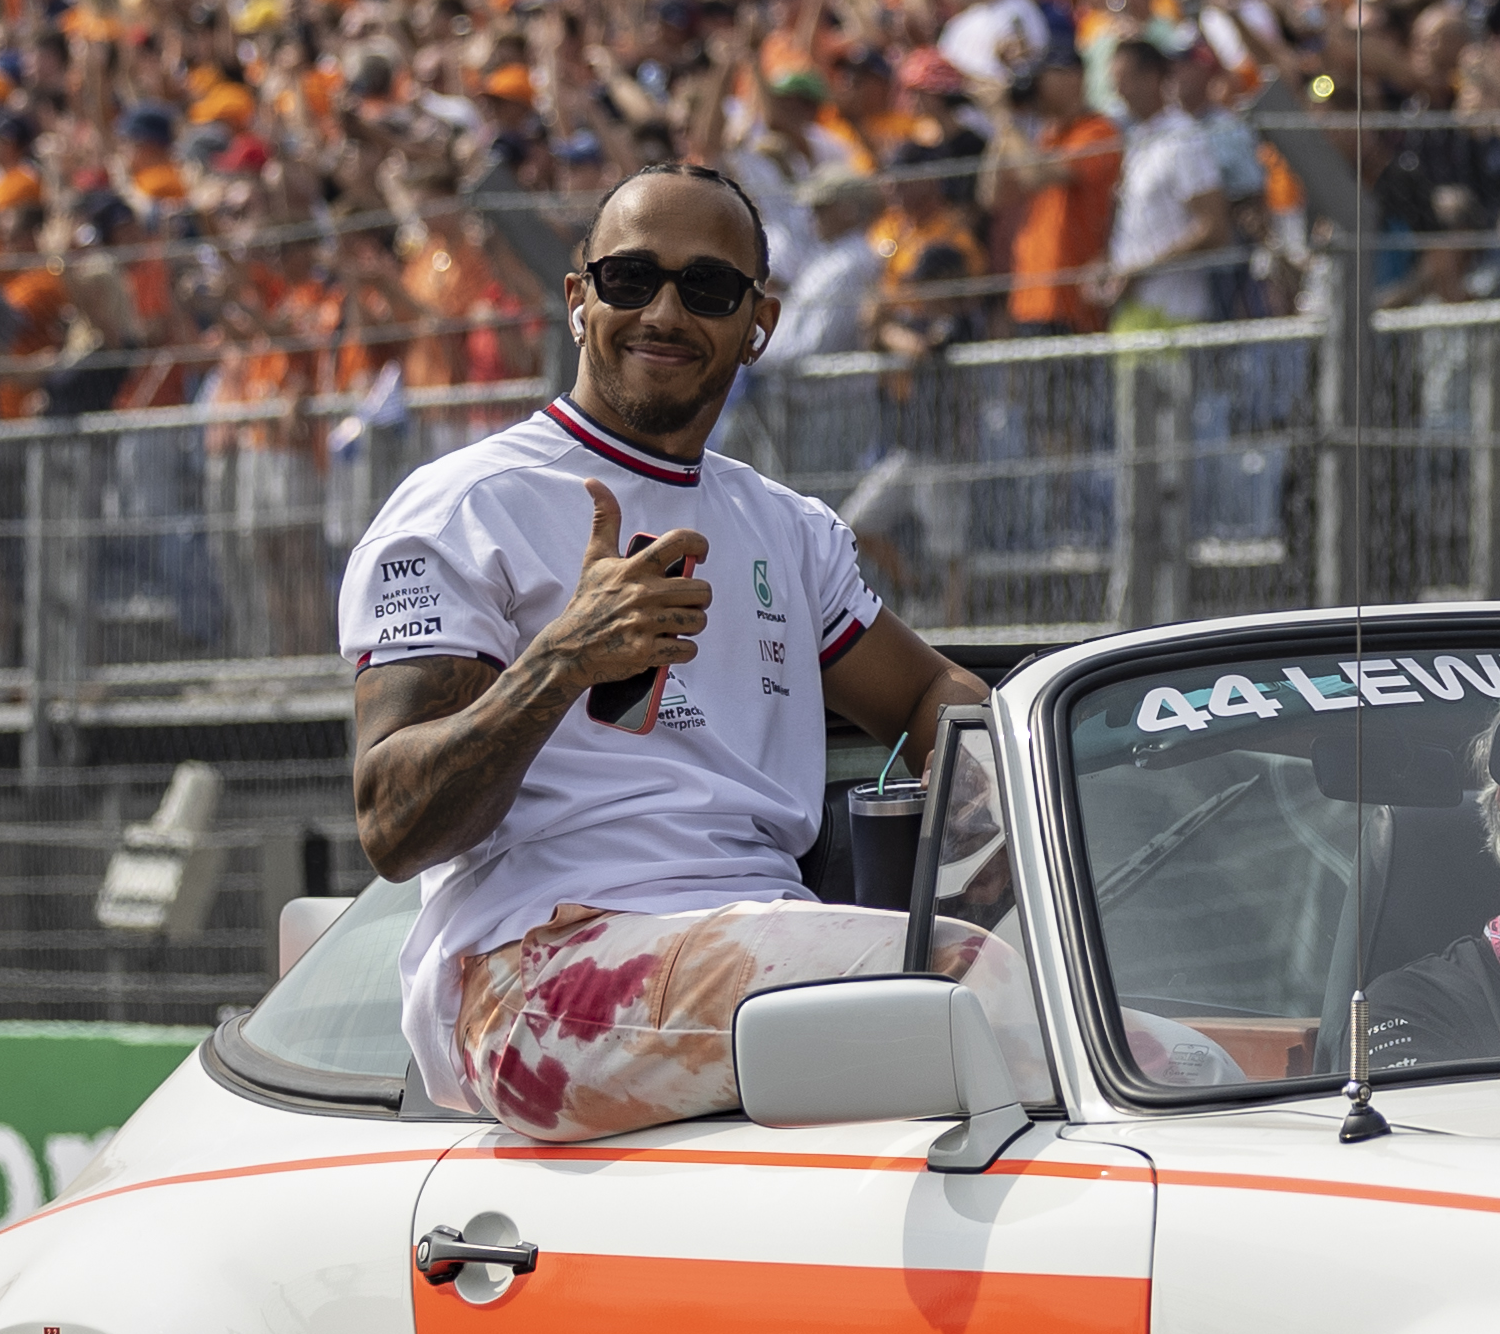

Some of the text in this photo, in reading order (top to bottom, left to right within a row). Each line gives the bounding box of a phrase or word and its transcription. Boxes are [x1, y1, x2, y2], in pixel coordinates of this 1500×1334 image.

[380, 556, 426, 583] IWC
[375, 593, 441, 619] BONVOY
[382, 585, 431, 602] MARRIOTT
[756, 610, 787, 624] PETRONAS
[378, 620, 423, 644] AMD
[1136, 673, 1285, 733] 44
